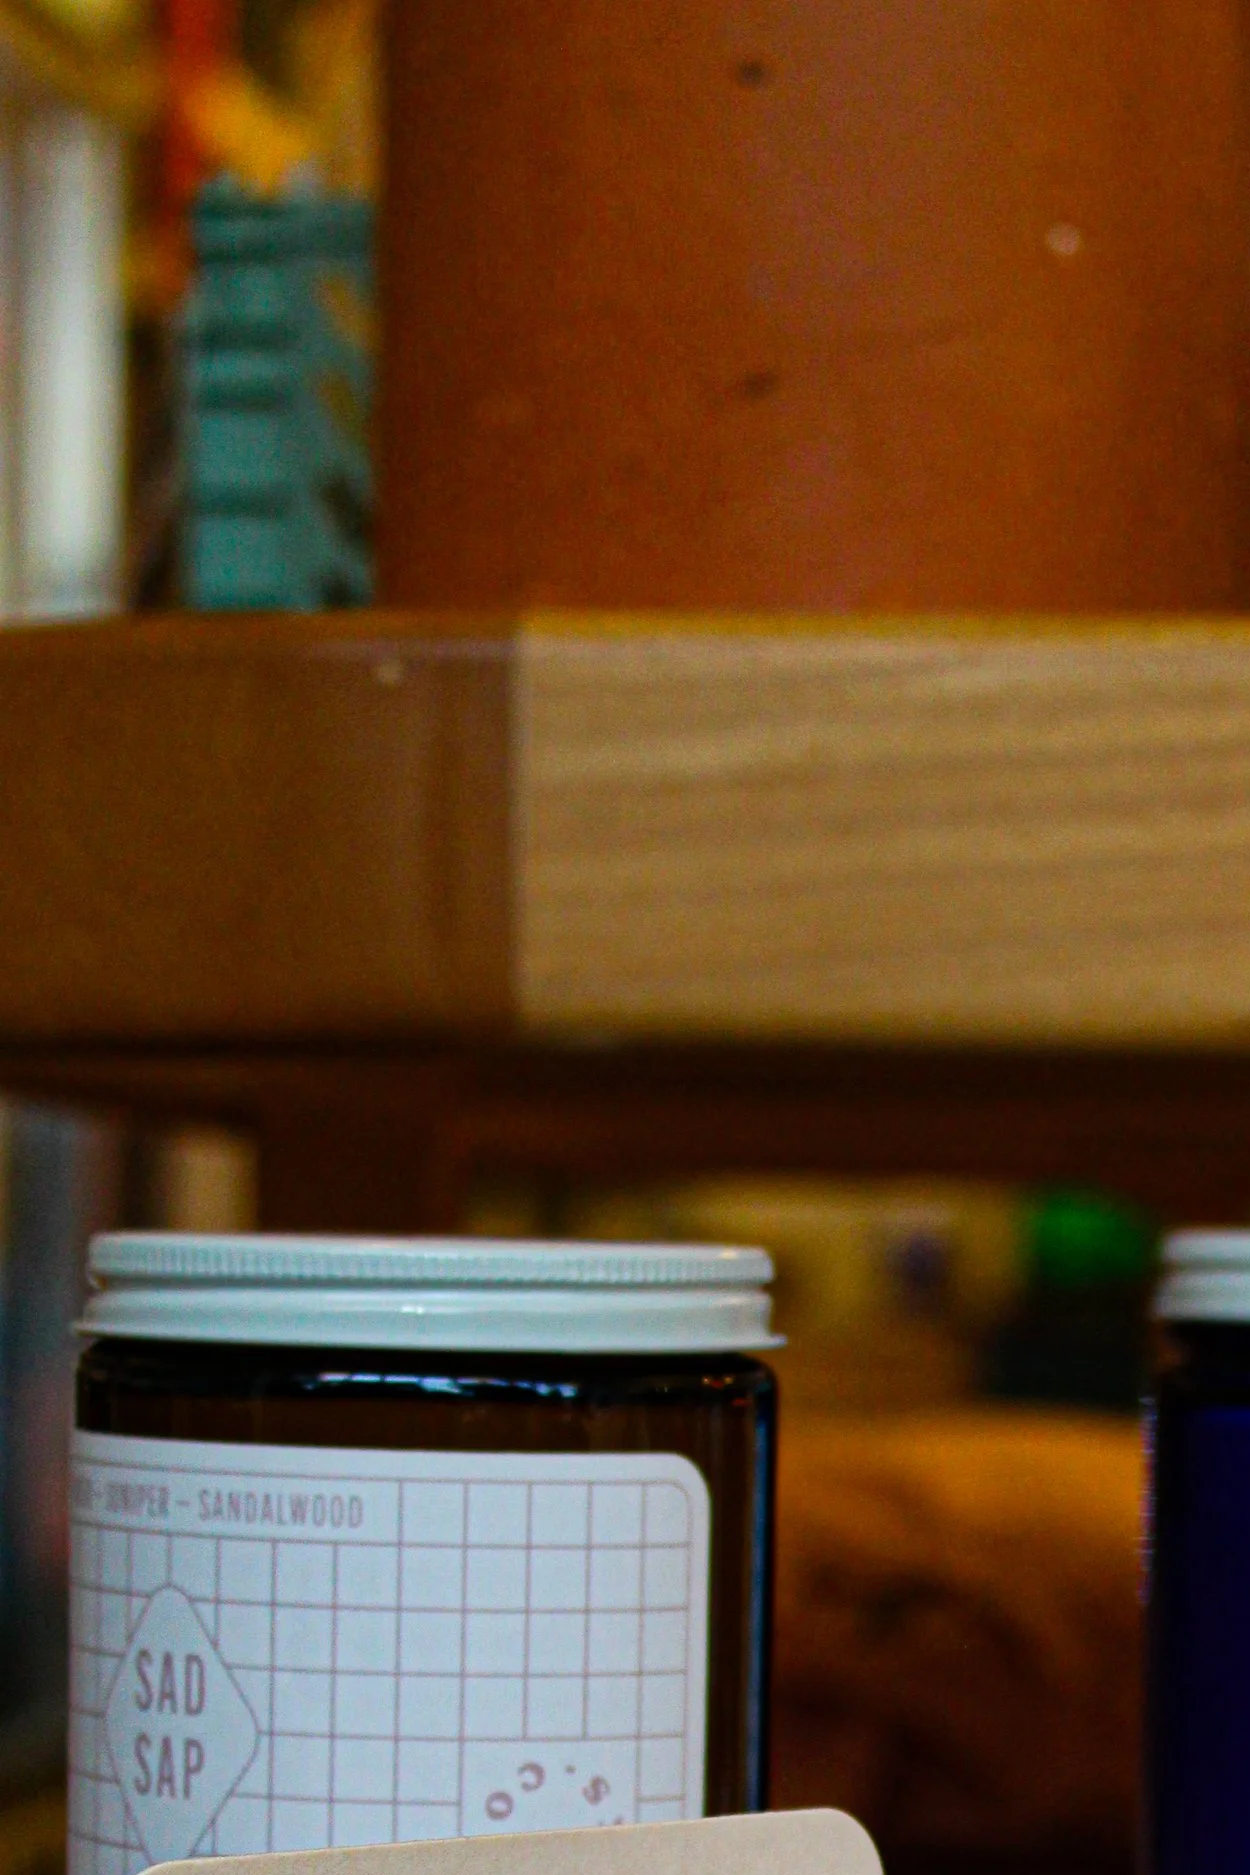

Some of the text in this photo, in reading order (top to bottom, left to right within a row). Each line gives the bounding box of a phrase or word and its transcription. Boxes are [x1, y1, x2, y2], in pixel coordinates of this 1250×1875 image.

[197, 1487, 365, 1530] SANDALWOOD
[134, 1647, 206, 1716] SAD
[133, 1732, 206, 1802] SAP
